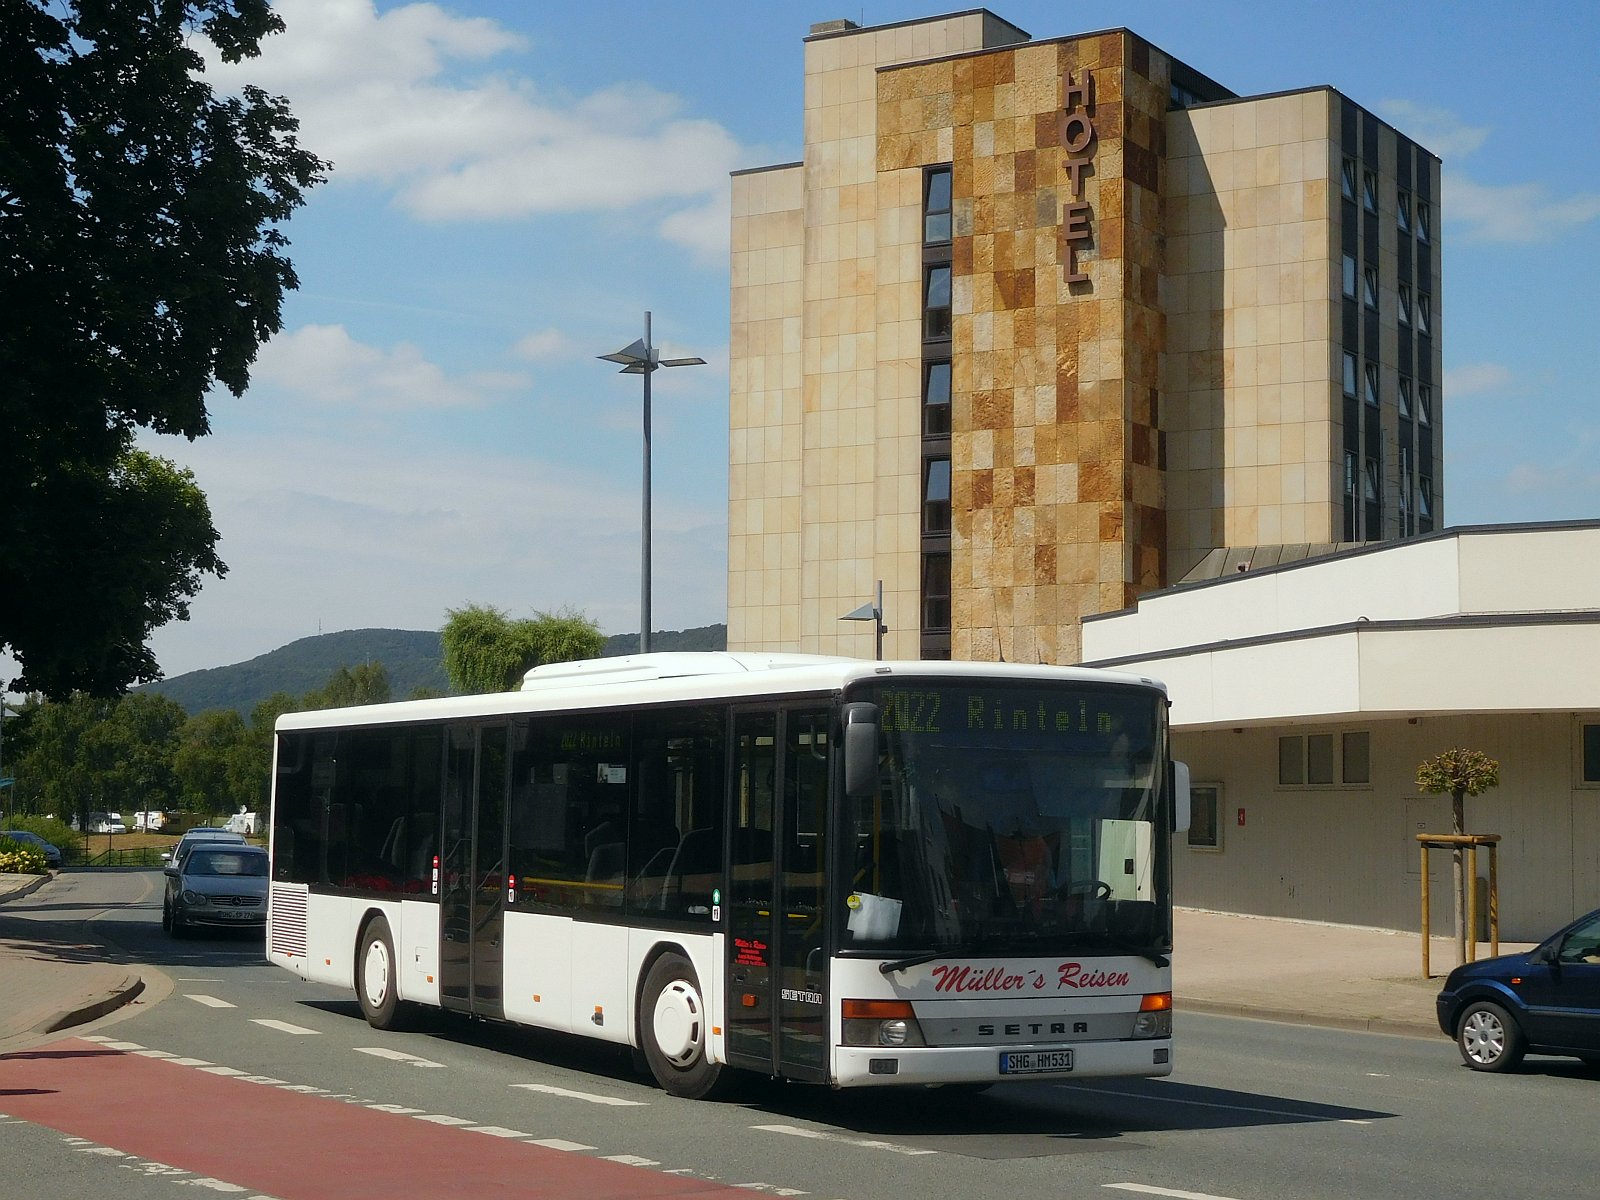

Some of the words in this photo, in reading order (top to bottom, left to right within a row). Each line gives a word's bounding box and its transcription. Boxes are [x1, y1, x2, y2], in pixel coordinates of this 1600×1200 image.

[1060, 68, 1092, 284] HOTEL
[880, 690, 942, 733] 2022
[966, 695, 1113, 734] Rinteln
[1057, 962, 1130, 990] Reisen
[781, 988, 823, 1005] SETRA
[978, 1021, 1089, 1036] SETRA
[1008, 1054, 1030, 1069] SHG
